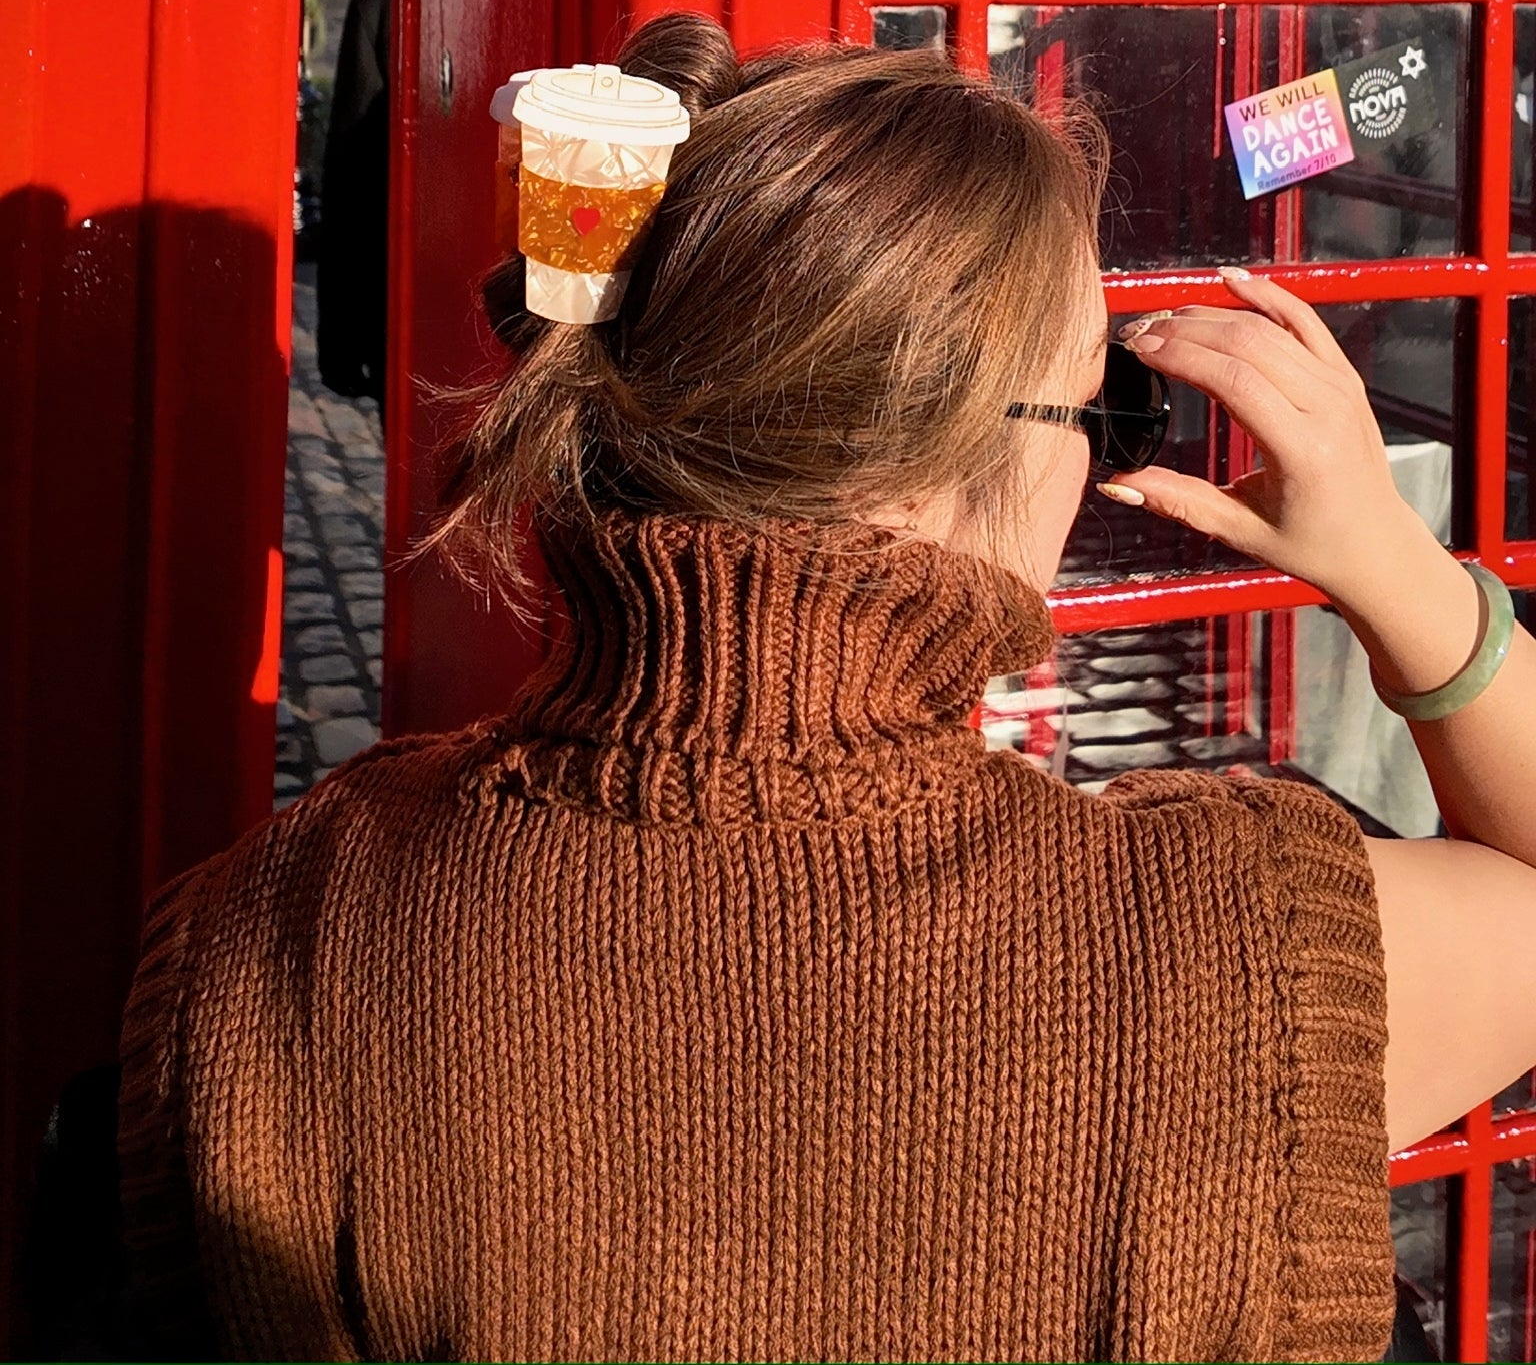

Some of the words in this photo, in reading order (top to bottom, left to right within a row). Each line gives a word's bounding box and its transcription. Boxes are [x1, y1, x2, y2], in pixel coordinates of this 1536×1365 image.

[1239, 98, 1272, 124] WE
[1276, 82, 1325, 110] WILL
[1242, 98, 1333, 152] DANCE
[1253, 125, 1339, 179] AGAIN
[1257, 163, 1312, 192] Remember
[1313, 153, 1338, 172] 7/10
